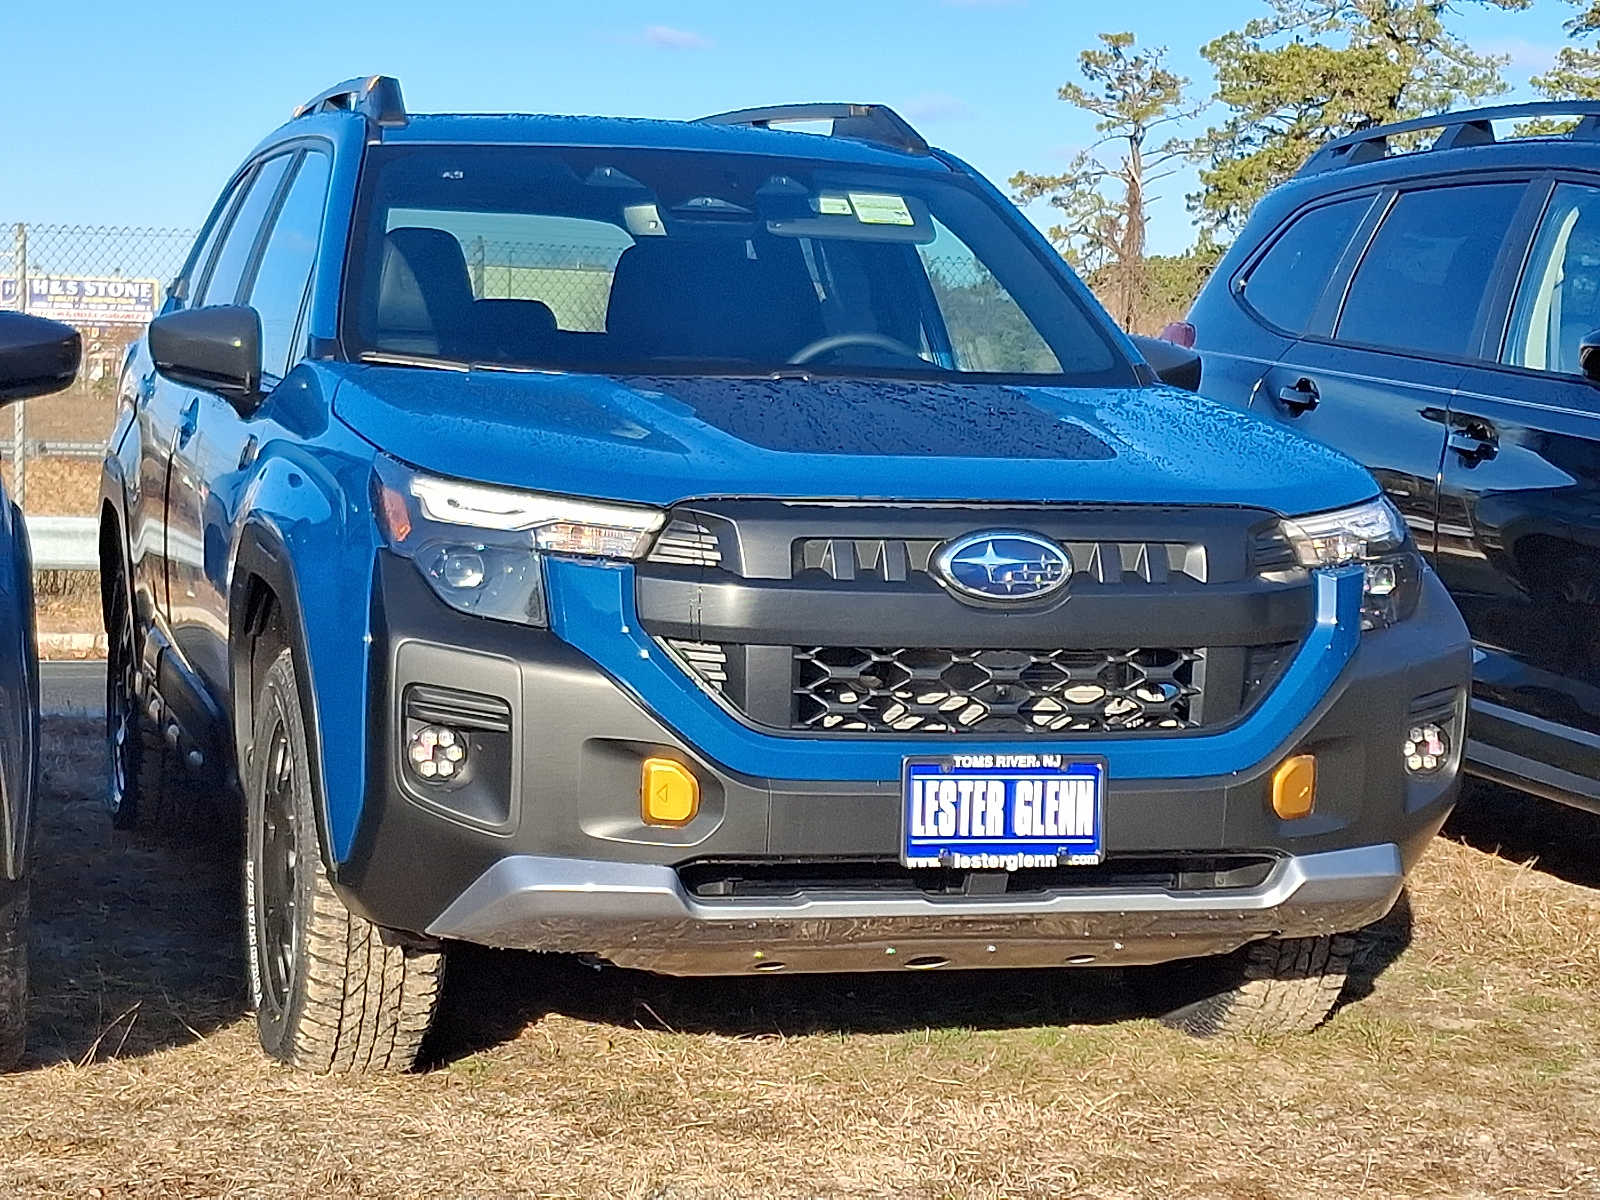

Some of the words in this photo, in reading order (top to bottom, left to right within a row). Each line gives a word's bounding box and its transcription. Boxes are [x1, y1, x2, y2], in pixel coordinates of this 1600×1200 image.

[33, 279, 78, 296] H&S
[84, 283, 152, 298] STONE
[953, 755, 994, 768] TOMS
[1043, 755, 1061, 768] NJ
[912, 780, 1005, 837] LESTER
[1014, 780, 1095, 836] GLENN
[954, 853, 1057, 871] lesterglenn
